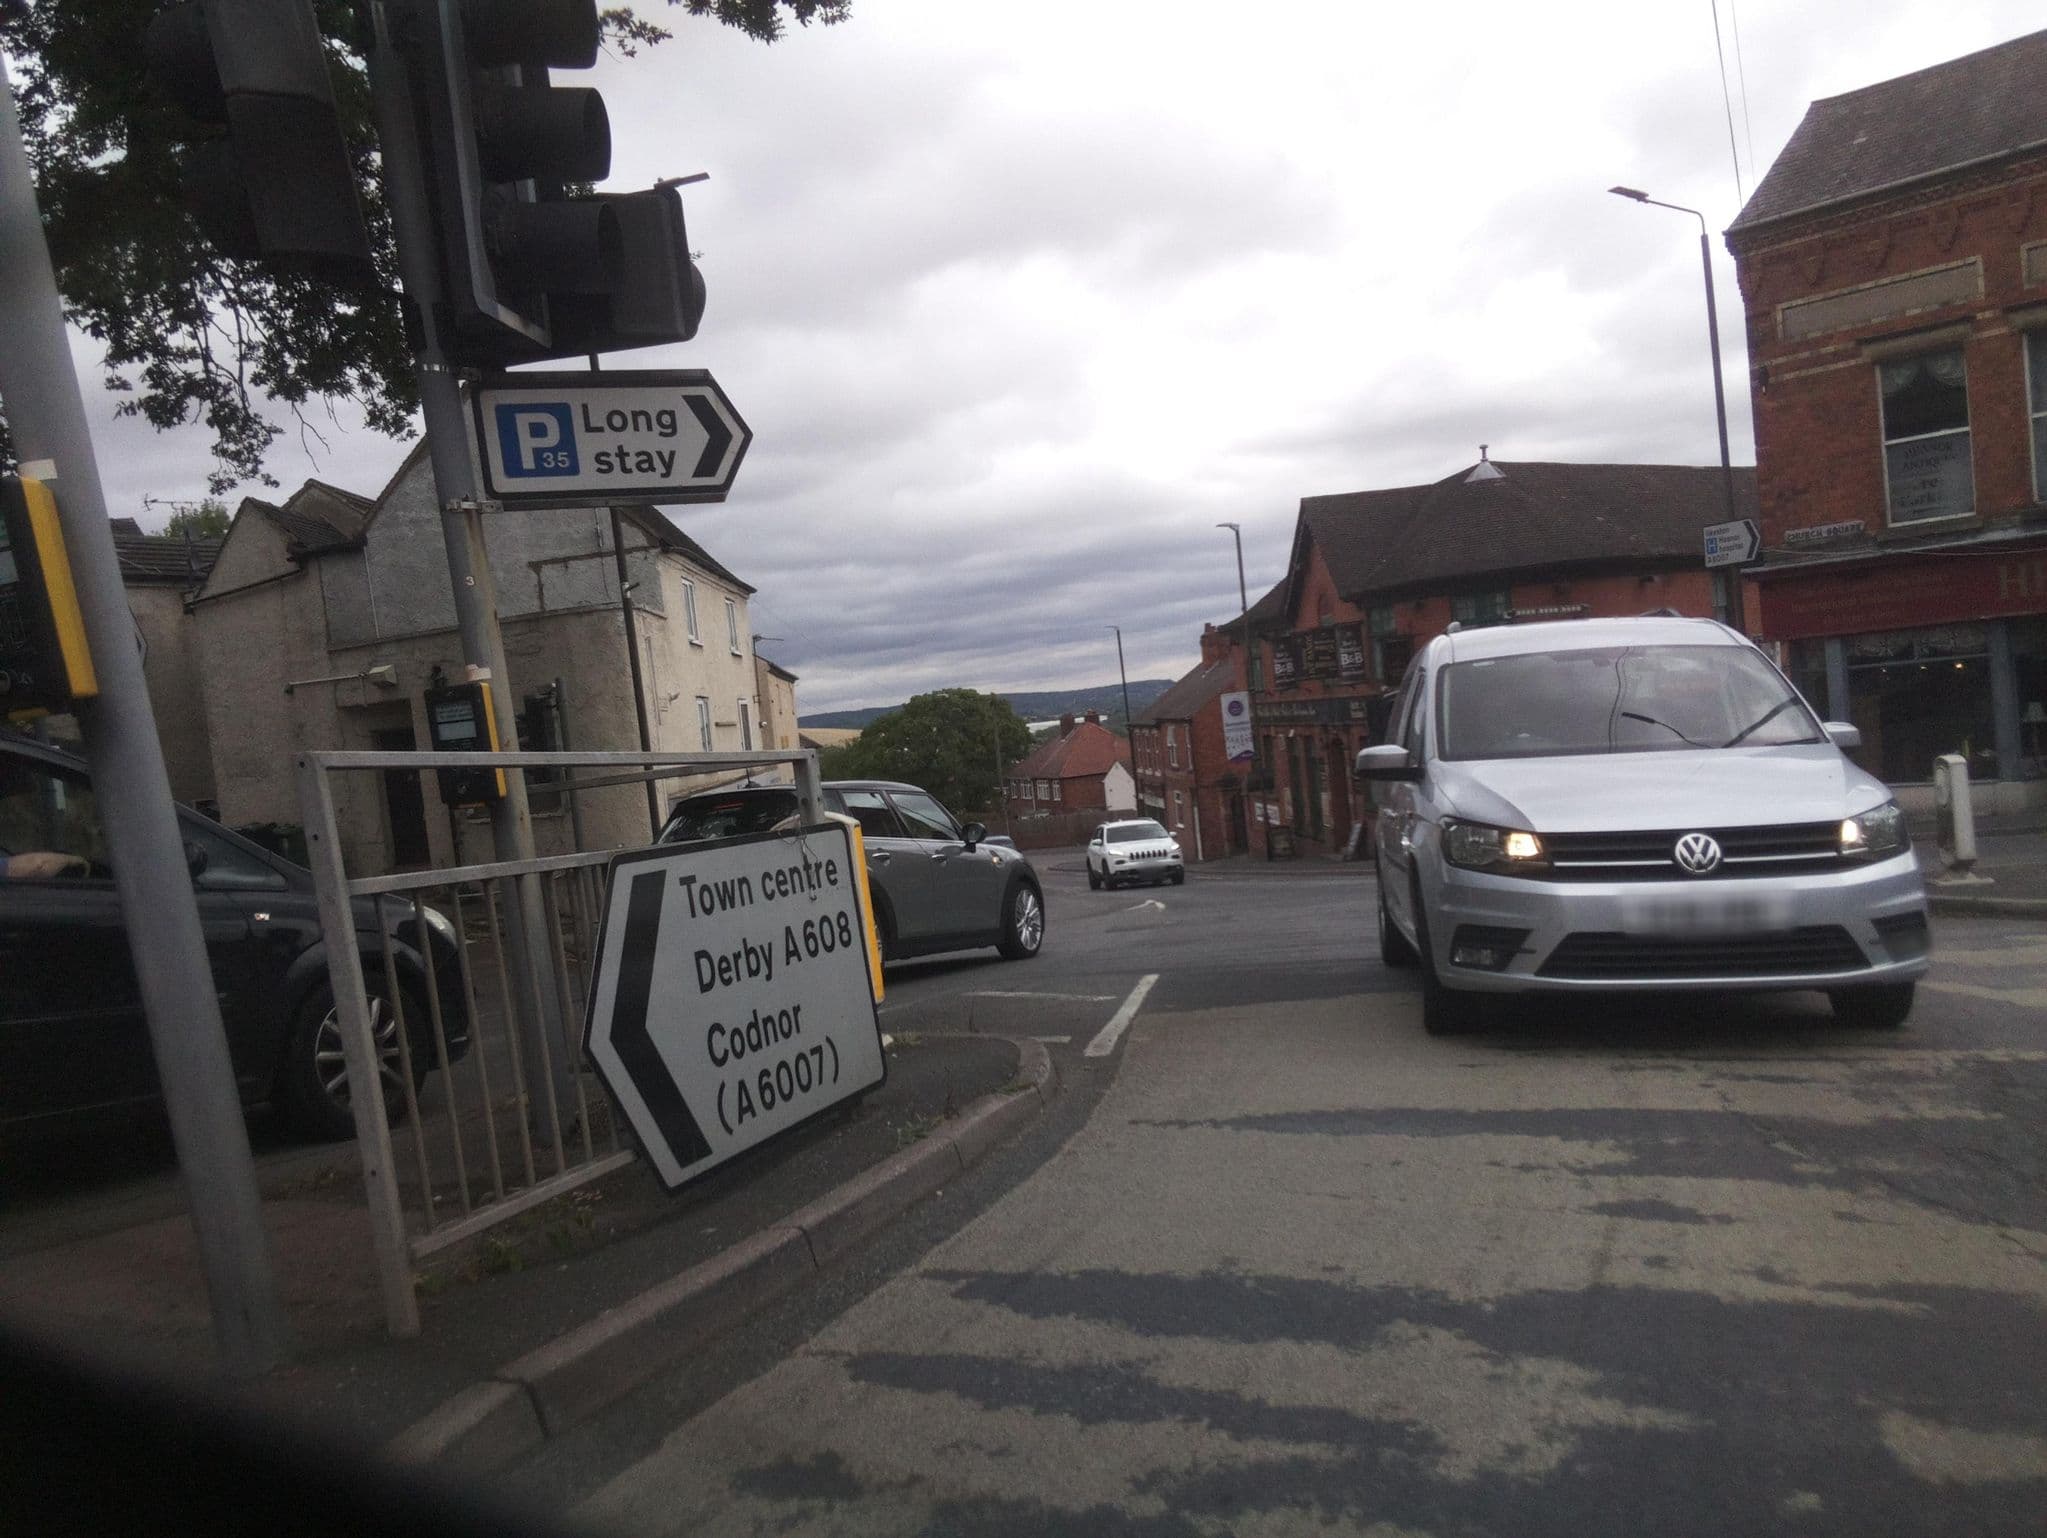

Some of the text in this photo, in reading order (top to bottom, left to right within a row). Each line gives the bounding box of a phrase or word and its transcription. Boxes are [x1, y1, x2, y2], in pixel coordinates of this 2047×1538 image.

[513, 411, 561, 470] P
[581, 403, 677, 438] Long
[542, 452, 570, 469] 35
[594, 444, 676, 478] stay
[1787, 528, 1823, 542] CHURCH
[680, 858, 838, 919] Town centre
[694, 910, 853, 994] Derby A608
[706, 1003, 803, 1068] Codnor
[716, 1036, 840, 1135] (A6007)
